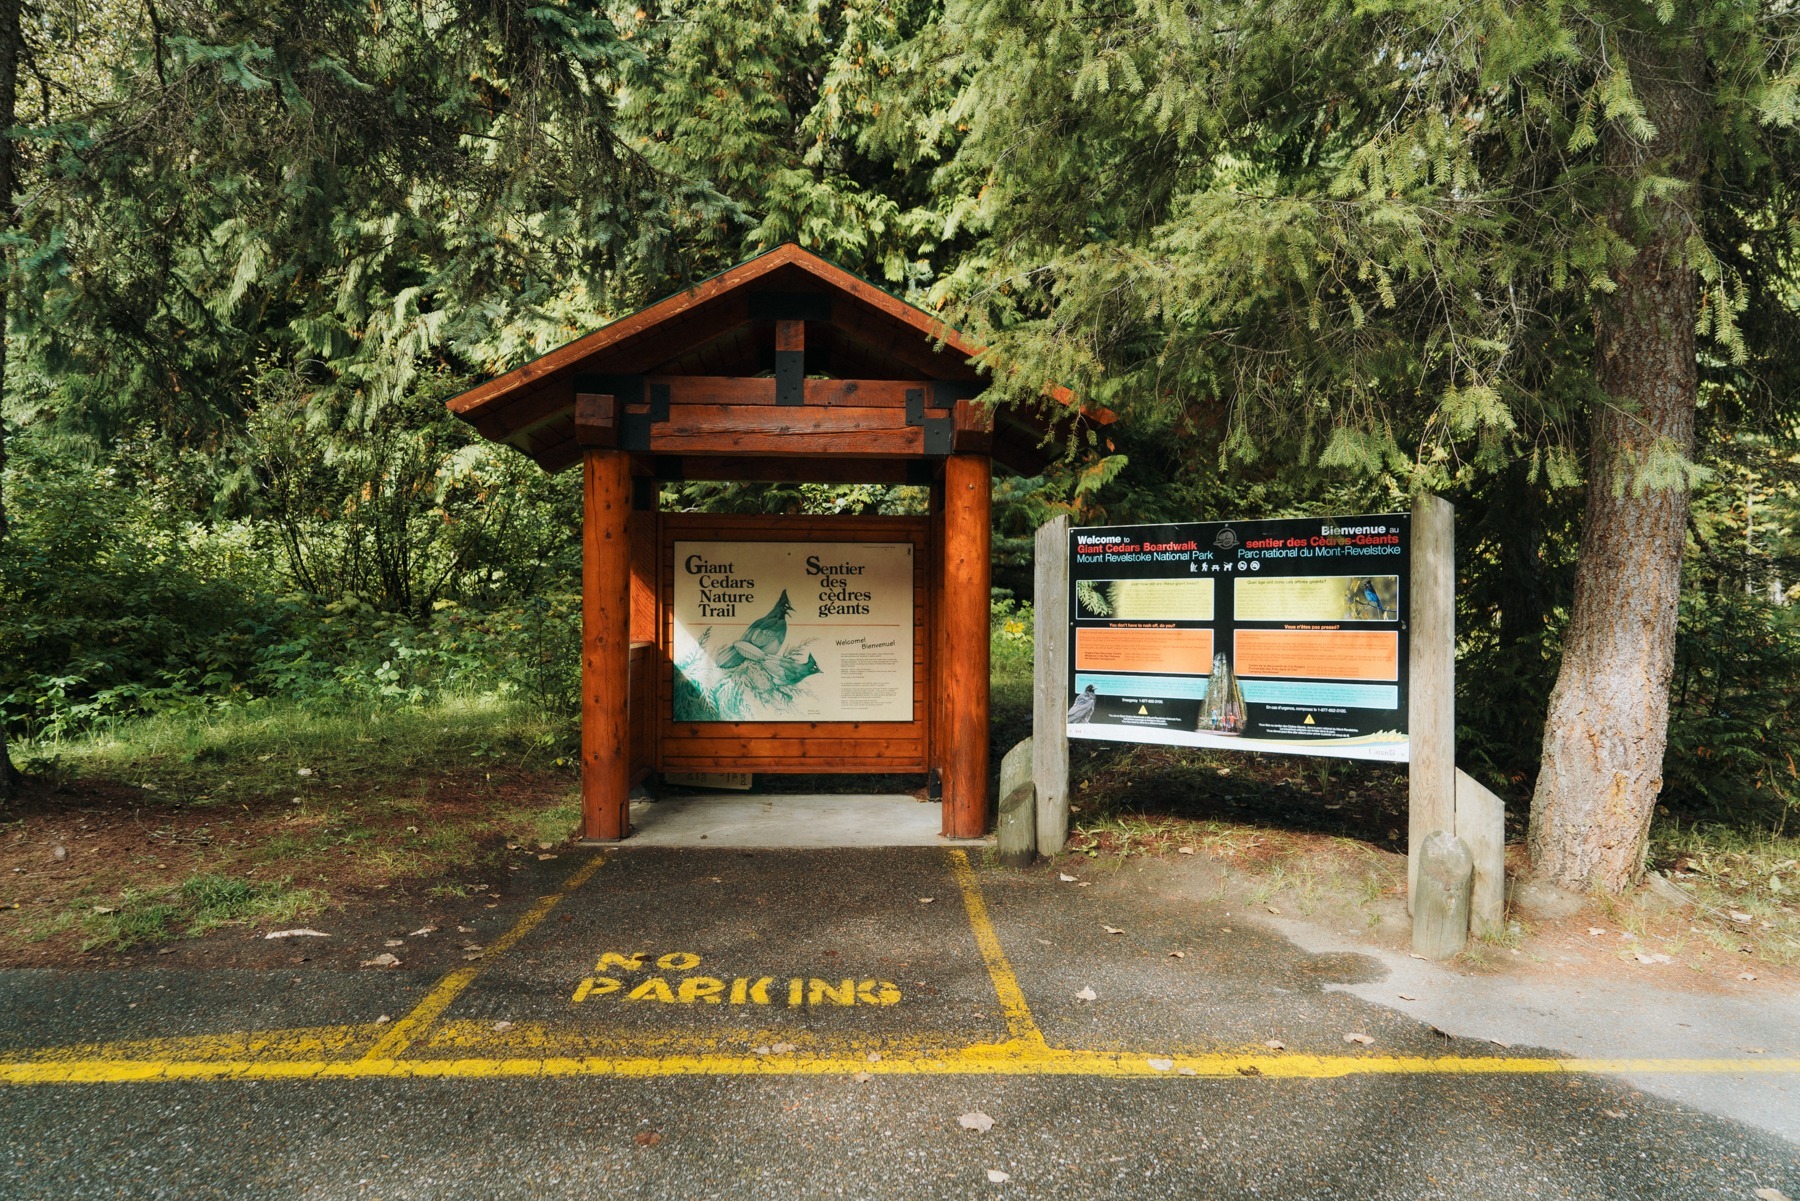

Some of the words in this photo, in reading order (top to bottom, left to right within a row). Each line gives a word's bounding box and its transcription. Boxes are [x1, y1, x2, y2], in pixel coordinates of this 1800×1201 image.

[1321, 526, 1386, 536] Bienvenue
[1077, 536, 1122, 544] Welcome
[1246, 538, 1284, 548] sentier
[1286, 538, 1308, 546] des
[1078, 544, 1104, 554] Giant
[1106, 544, 1140, 552] Cedars
[1143, 541, 1198, 552] Boardwalk
[1238, 548, 1260, 558] Parc
[1262, 547, 1298, 558] national
[1300, 547, 1313, 557] du
[1316, 545, 1400, 556] Mont-Revelstoke
[1076, 554, 1104, 563] Mount
[1106, 552, 1152, 562] Revelstoke
[1154, 551, 1190, 561] National
[1192, 550, 1214, 560] Park
[685, 554, 734, 575] Giant
[806, 556, 866, 576] Sentier
[699, 575, 754, 588] Cedars
[820, 575, 848, 588] des
[700, 590, 754, 603] Nature
[818, 588, 872, 602] cèdres
[698, 604, 736, 618] Trail
[818, 602, 870, 618] géants
[836, 636, 866, 646] Welcome!
[862, 640, 896, 650] Bienvenue!
[594, 952, 701, 972] NO
[571, 976, 902, 1005] PARKING
